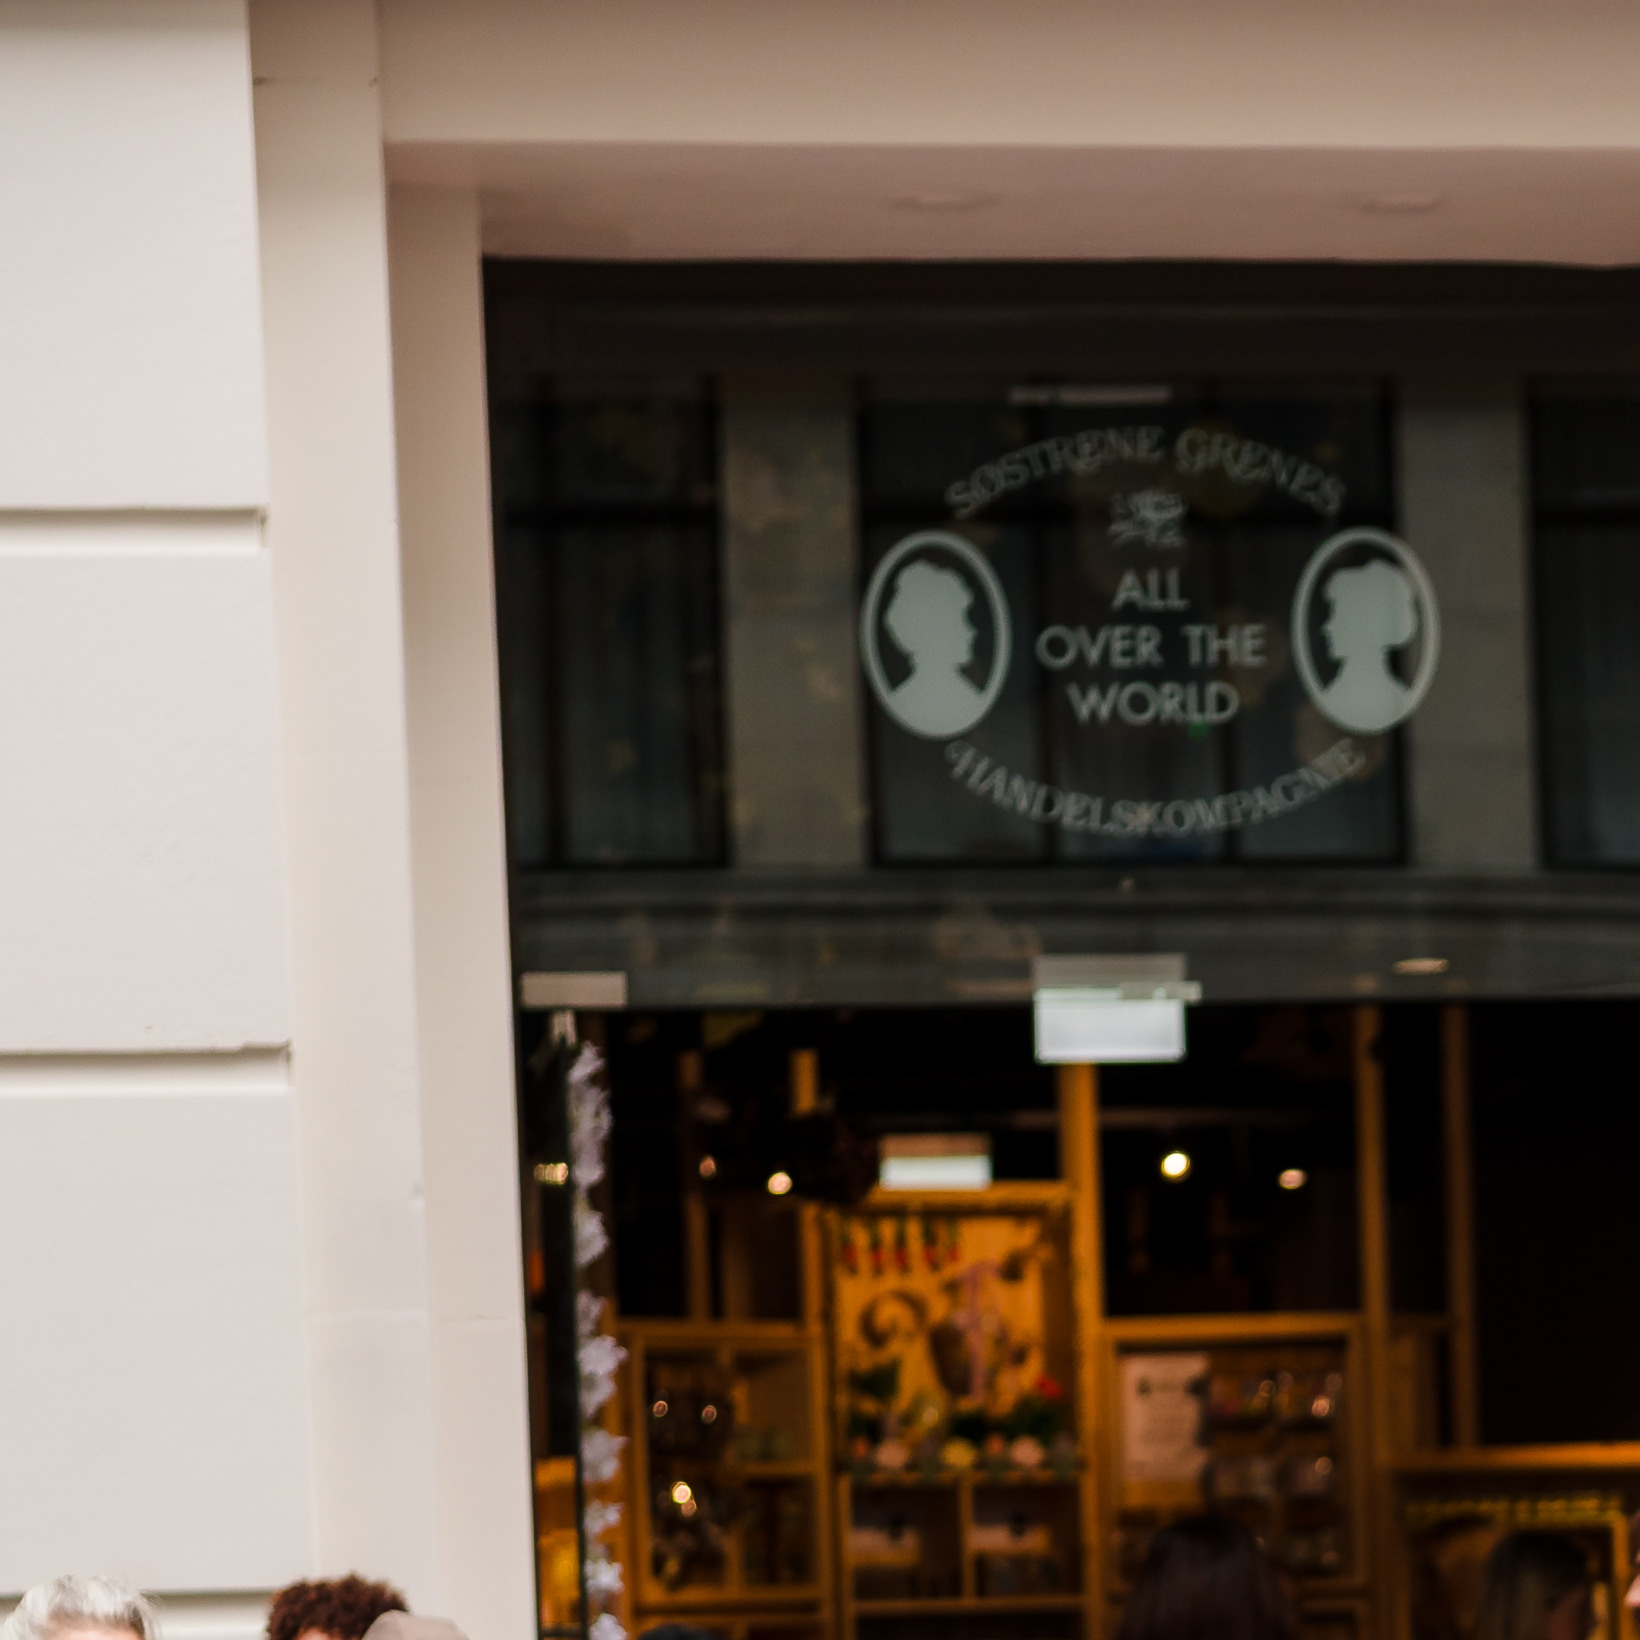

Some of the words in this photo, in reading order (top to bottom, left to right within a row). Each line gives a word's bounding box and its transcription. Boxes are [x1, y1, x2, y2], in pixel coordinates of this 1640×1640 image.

[1174, 428, 1348, 517] GRENES
[1110, 569, 1189, 611] ALL
[1035, 625, 1163, 670] OVER
[1180, 624, 1267, 668] THE
[1067, 682, 1240, 726] WORLD
